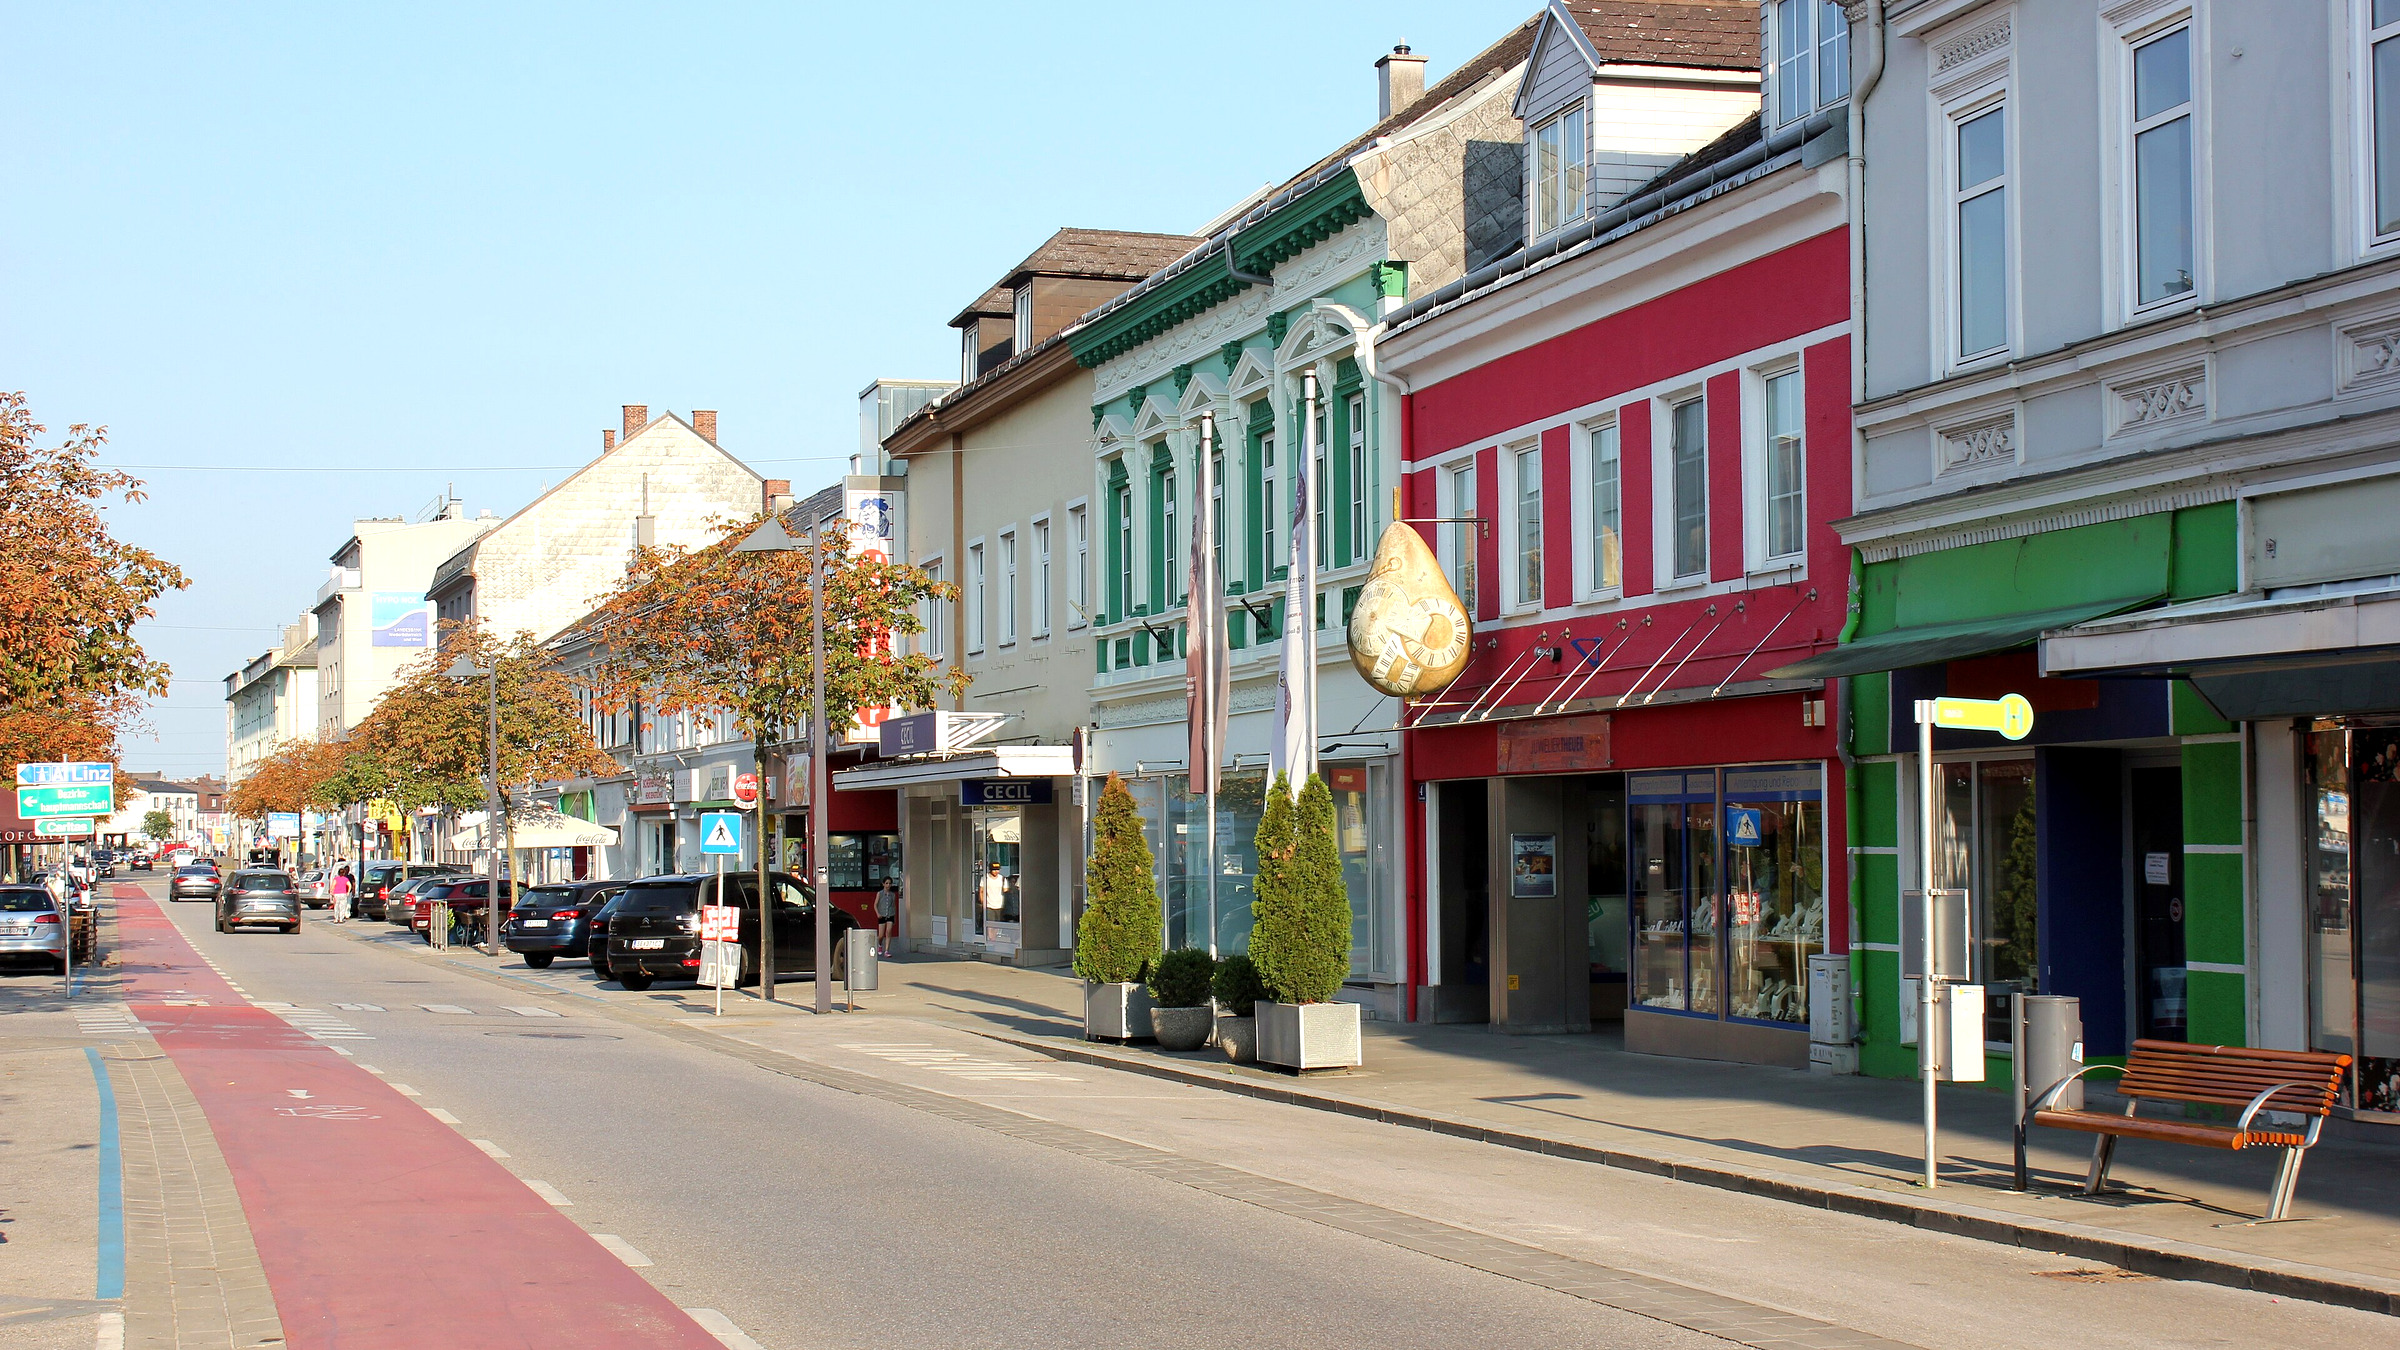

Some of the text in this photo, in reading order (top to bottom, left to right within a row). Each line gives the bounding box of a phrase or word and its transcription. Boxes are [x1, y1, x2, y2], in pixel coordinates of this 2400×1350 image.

[376, 596, 399, 604] HYPO
[900, 726, 914, 745] CECIL
[71, 765, 110, 781] Linz
[57, 788, 90, 799] Bezirks-
[983, 785, 1031, 799] CECIL
[40, 800, 108, 813] hauptmannschaft
[46, 822, 88, 832] Caritas
